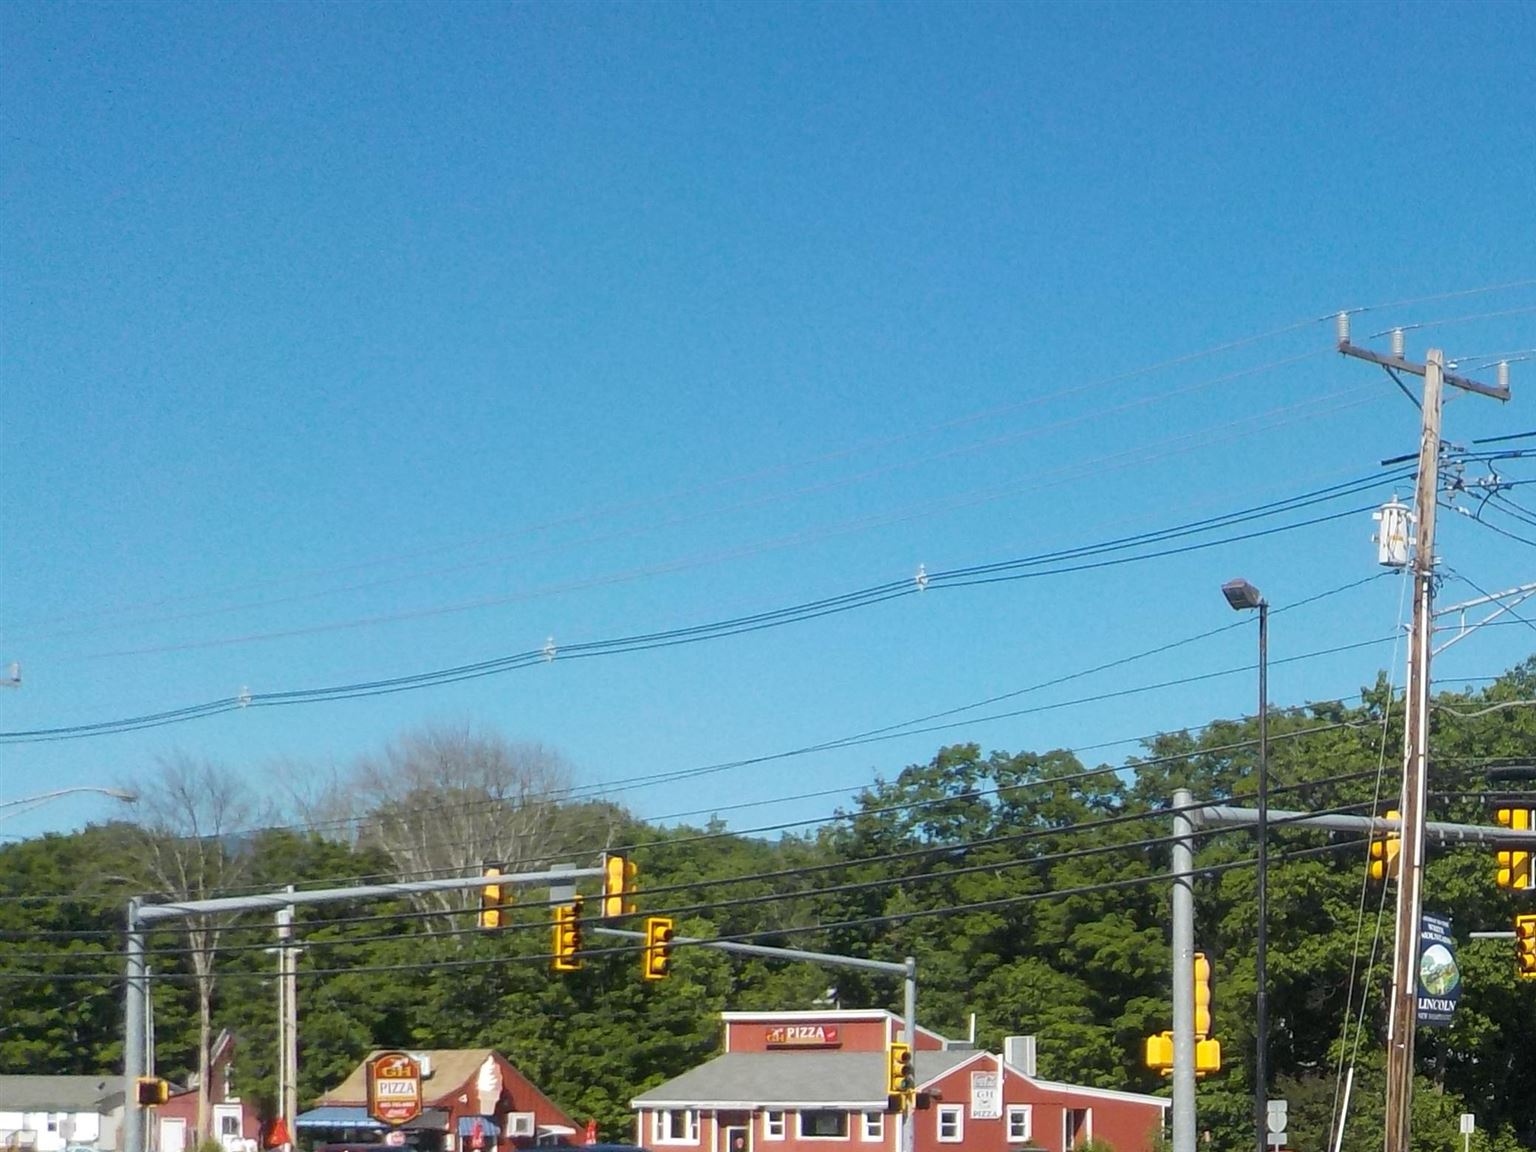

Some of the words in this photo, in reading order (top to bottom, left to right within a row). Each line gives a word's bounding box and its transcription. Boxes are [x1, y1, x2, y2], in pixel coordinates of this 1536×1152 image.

[1418, 997, 1457, 1012] LINCOLN
[786, 1026, 826, 1039] PIZZA
[379, 1081, 415, 1095] PIZZA
